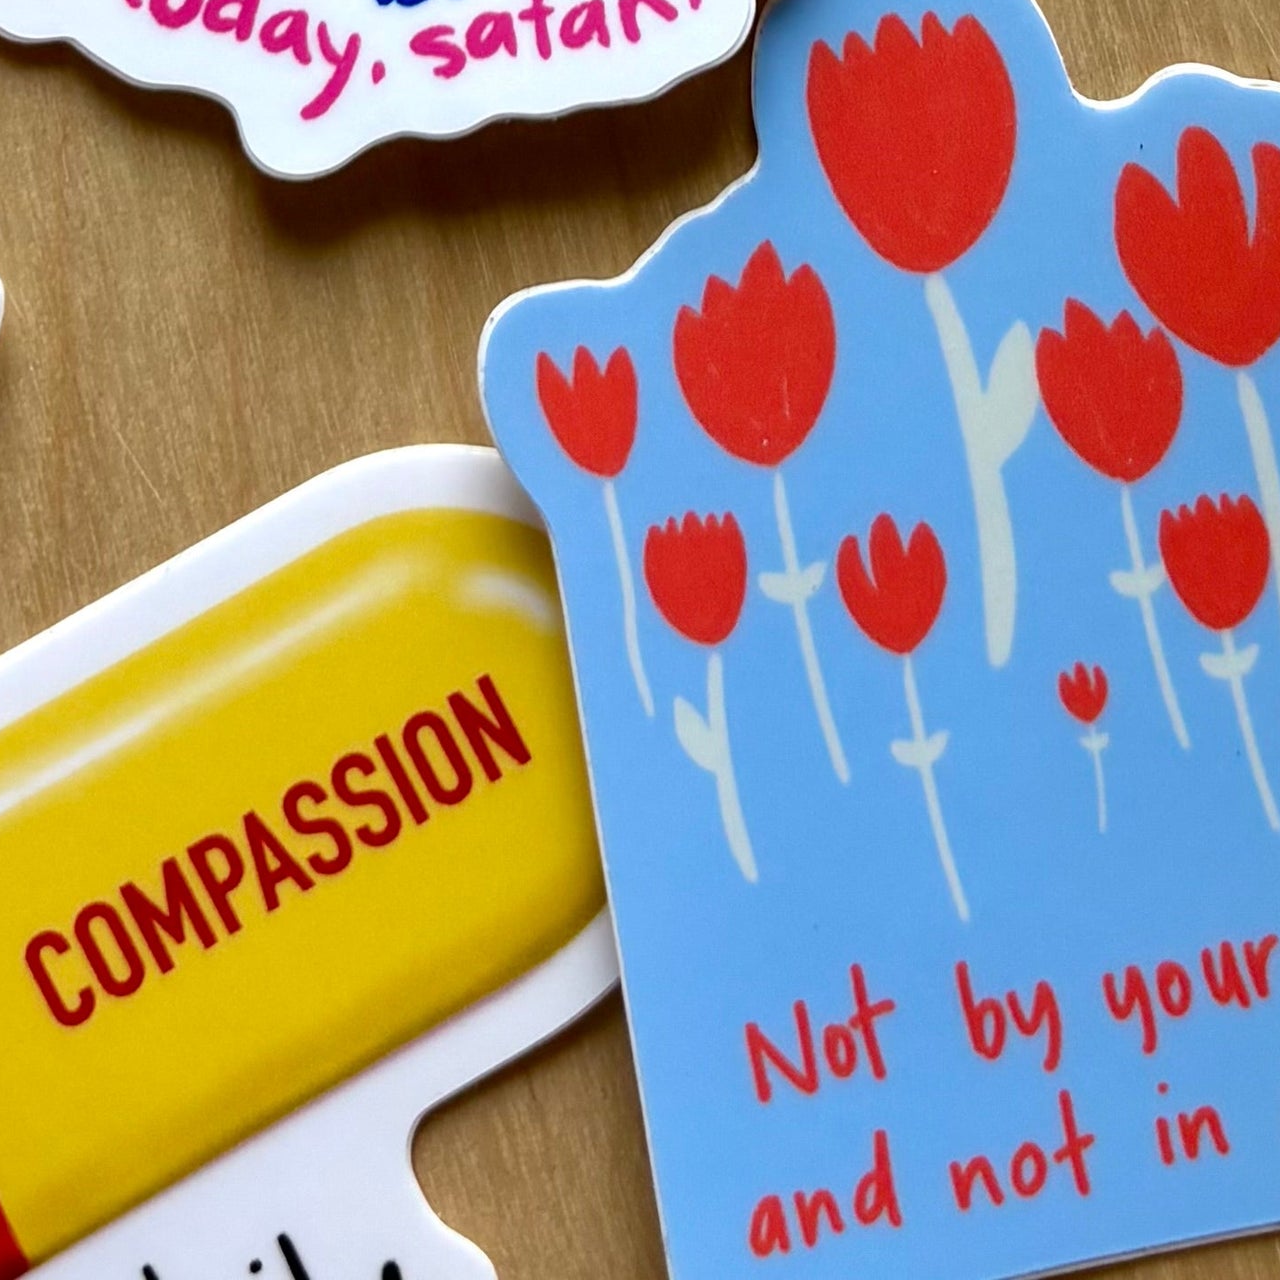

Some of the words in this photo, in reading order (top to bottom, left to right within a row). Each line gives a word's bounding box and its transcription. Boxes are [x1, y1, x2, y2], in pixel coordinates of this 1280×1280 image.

[24, 673, 533, 1028] COMPASSION
[745, 963, 896, 1102] Not
[956, 961, 1062, 1072] by
[747, 1129, 903, 1258] and
[949, 1089, 1096, 1212] not
[1155, 1083, 1231, 1166] in
